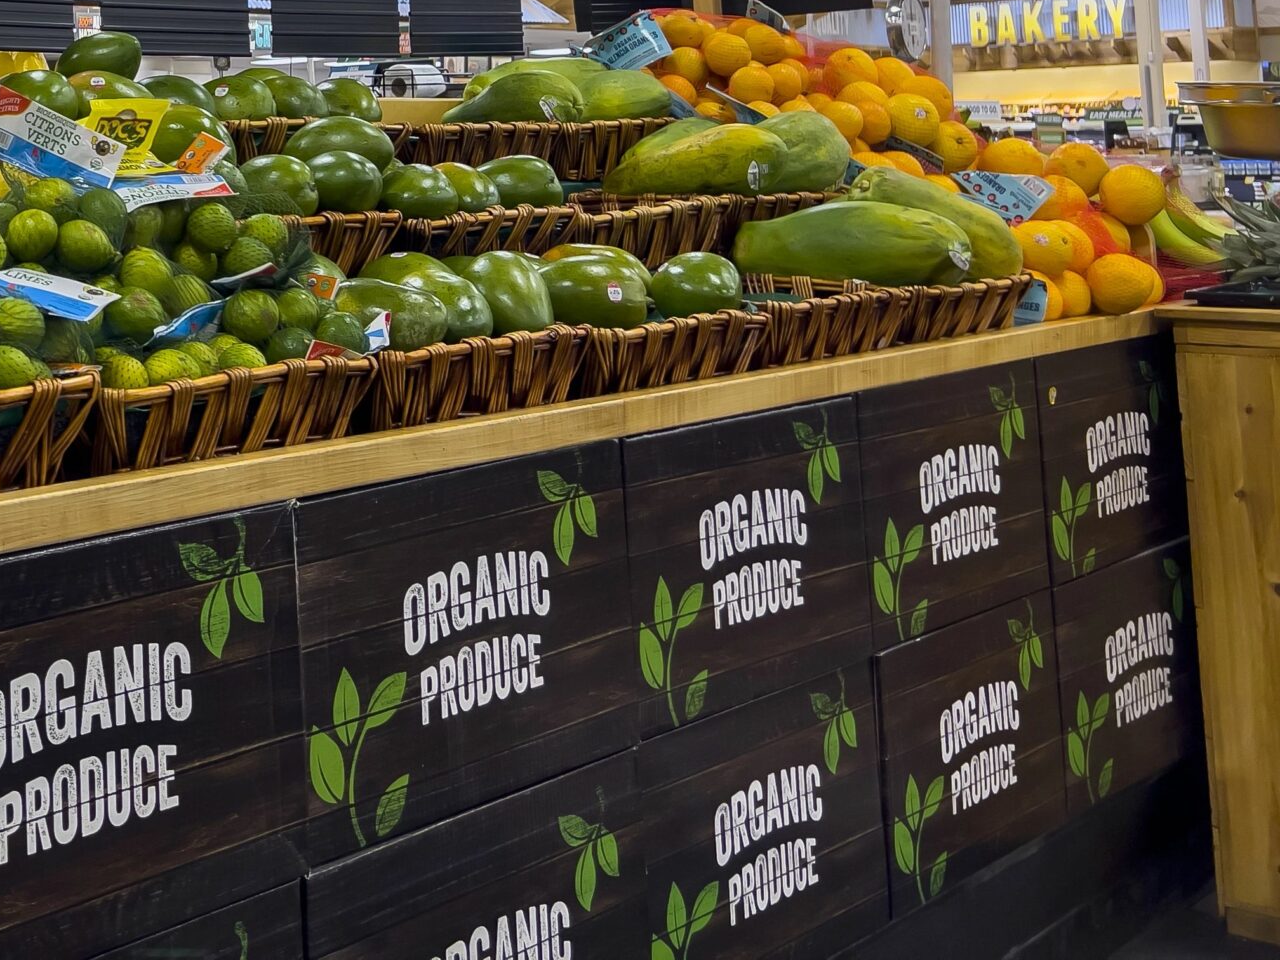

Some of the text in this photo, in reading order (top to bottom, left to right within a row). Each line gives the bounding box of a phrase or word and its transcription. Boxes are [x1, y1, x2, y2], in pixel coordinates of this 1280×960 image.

[613, 32, 638, 51] ORGANIC
[629, 31, 659, 52] ORANES
[24, 111, 82, 147] CITRONS
[27, 127, 68, 156] VERTS
[1089, 111, 1107, 120] EASY
[1108, 110, 1132, 119] MEALS
[122, 190, 190, 204] CITRONS
[3, 270, 53, 287] LIMES
[1087, 412, 1153, 474] ORGANIC
[919, 444, 1001, 515] ORGANIC
[1097, 465, 1152, 519] PRODUCE
[699, 488, 808, 571] ORGANIC
[931, 505, 999, 566] PRODUCE
[403, 550, 551, 657] ORGANIC
[713, 561, 805, 630] PRODUCE
[1105, 612, 1175, 685] ORGANIC
[420, 634, 545, 726] PRODUCE
[1116, 667, 1175, 729] PRODUCE
[940, 681, 1020, 766] ORGANIC
[951, 745, 1019, 817] PRODUCE
[713, 764, 824, 869] ORGANIC
[729, 837, 819, 927] PRODUCE
[431, 901, 571, 960] GANIC
